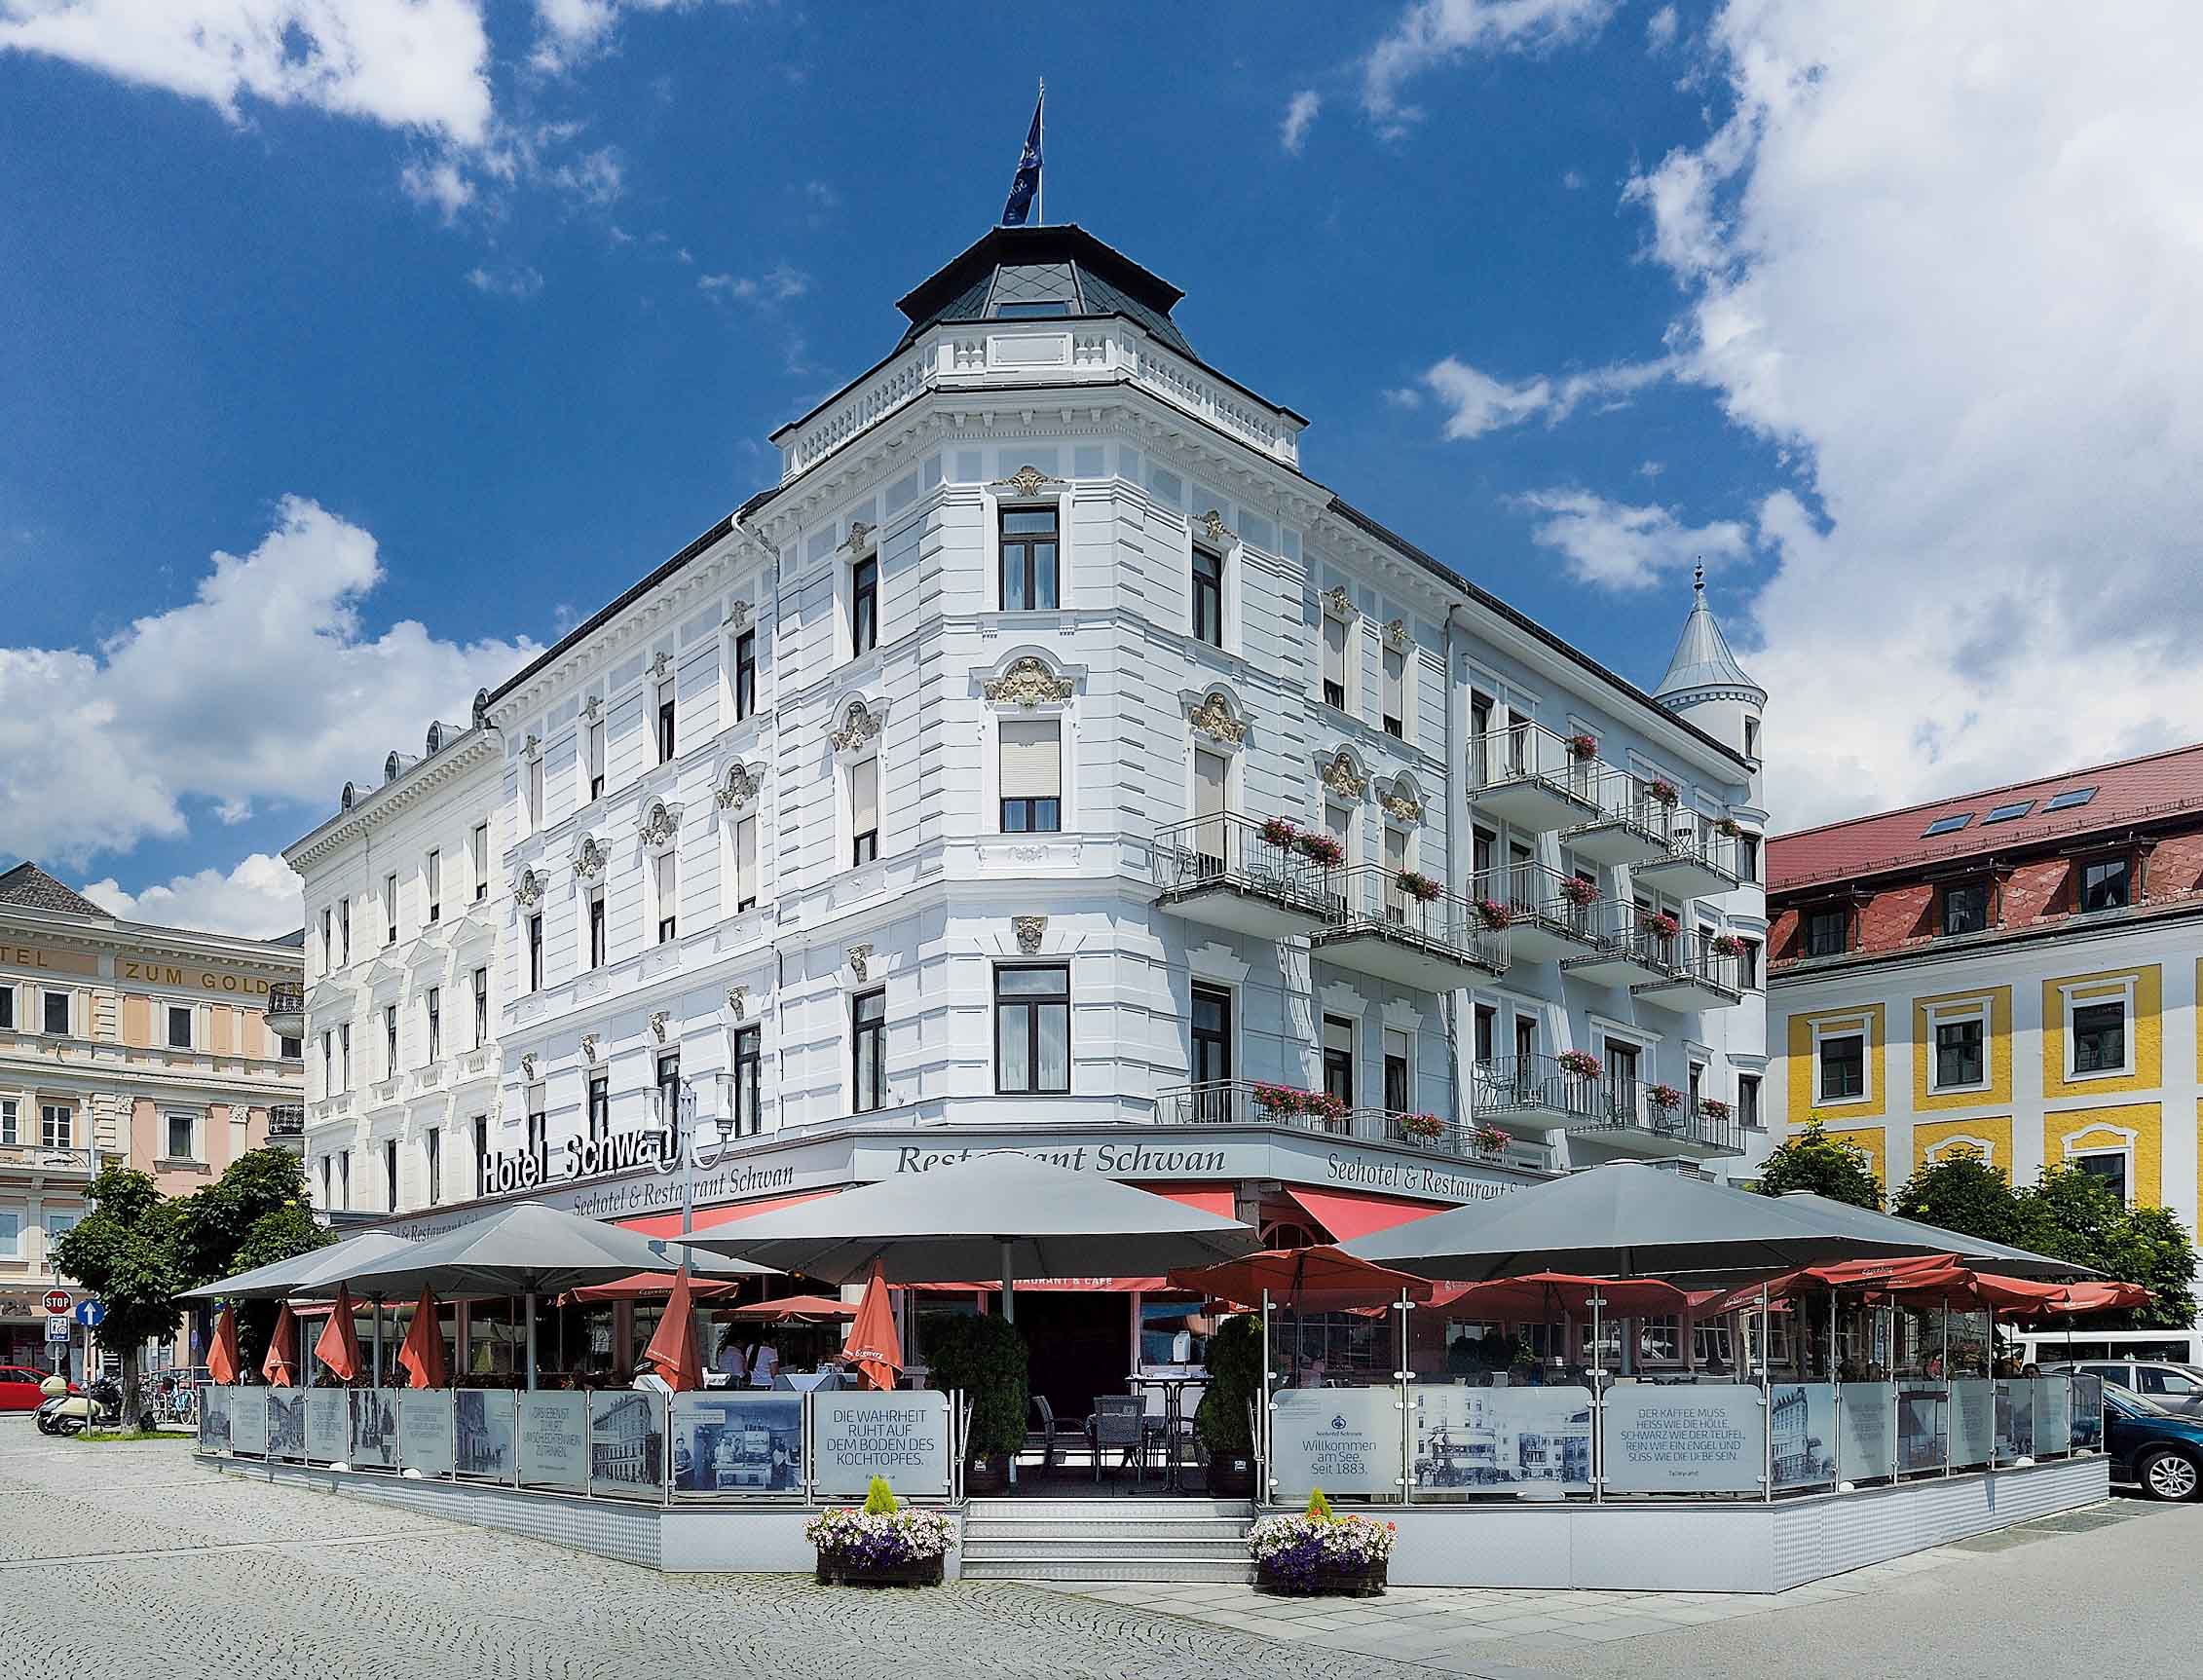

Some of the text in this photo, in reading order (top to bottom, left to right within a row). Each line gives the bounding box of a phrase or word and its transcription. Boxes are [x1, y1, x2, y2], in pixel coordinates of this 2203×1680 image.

[126, 962, 183, 986] ZUM
[201, 974, 304, 997] GOLD
[482, 1123, 675, 1194] Hotel Schwan
[1096, 1143, 1226, 1172] Schwan
[1326, 1152, 1507, 1201] Seehotel & Restaurant
[574, 1165, 794, 1216] Seehotel & Restarant Schwan
[46, 1297, 69, 1307] STOP
[834, 1409, 927, 1423] DIE WAHRHEIT
[1638, 1408, 1658, 1418] DER
[1698, 1408, 1726, 1418] MUSS
[1636, 1420, 1662, 1429] HEISS
[1663, 1420, 1683, 1429] WIE
[1683, 1419, 1699, 1429] DIE
[849, 1424, 913, 1437] RUHT AUF
[1621, 1431, 1667, 1440] SCHWARZ
[1668, 1431, 1688, 1439] WIE
[1689, 1430, 1708, 1439] DER
[827, 1437, 935, 1451] DEM BODEN DES
[1302, 1440, 1377, 1452] Willkommen
[1626, 1440, 1741, 1451] REIN WIE EIN ENGEL UND
[837, 1452, 925, 1466] KOCHTOPFES.
[1317, 1451, 1363, 1463] am See.
[1654, 1451, 1673, 1461] WIE
[1673, 1451, 1689, 1461] DIE
[1311, 1463, 1333, 1475] Seit
